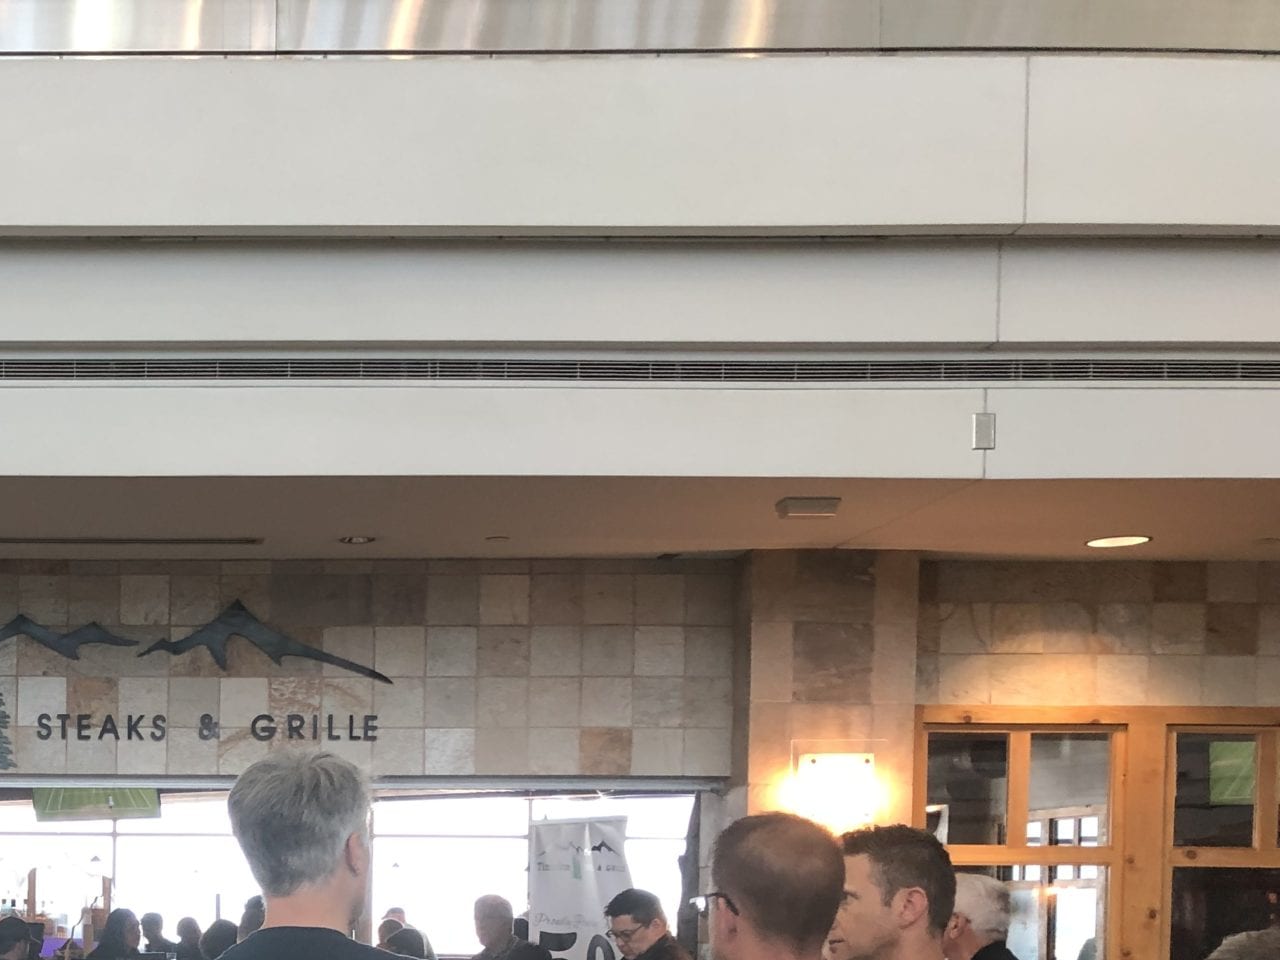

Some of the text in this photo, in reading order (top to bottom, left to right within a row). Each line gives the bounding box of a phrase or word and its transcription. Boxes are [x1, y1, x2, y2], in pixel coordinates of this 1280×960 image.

[36, 713, 167, 742] STEAKS
[198, 713, 220, 741] &
[250, 713, 379, 742] GRILLE
